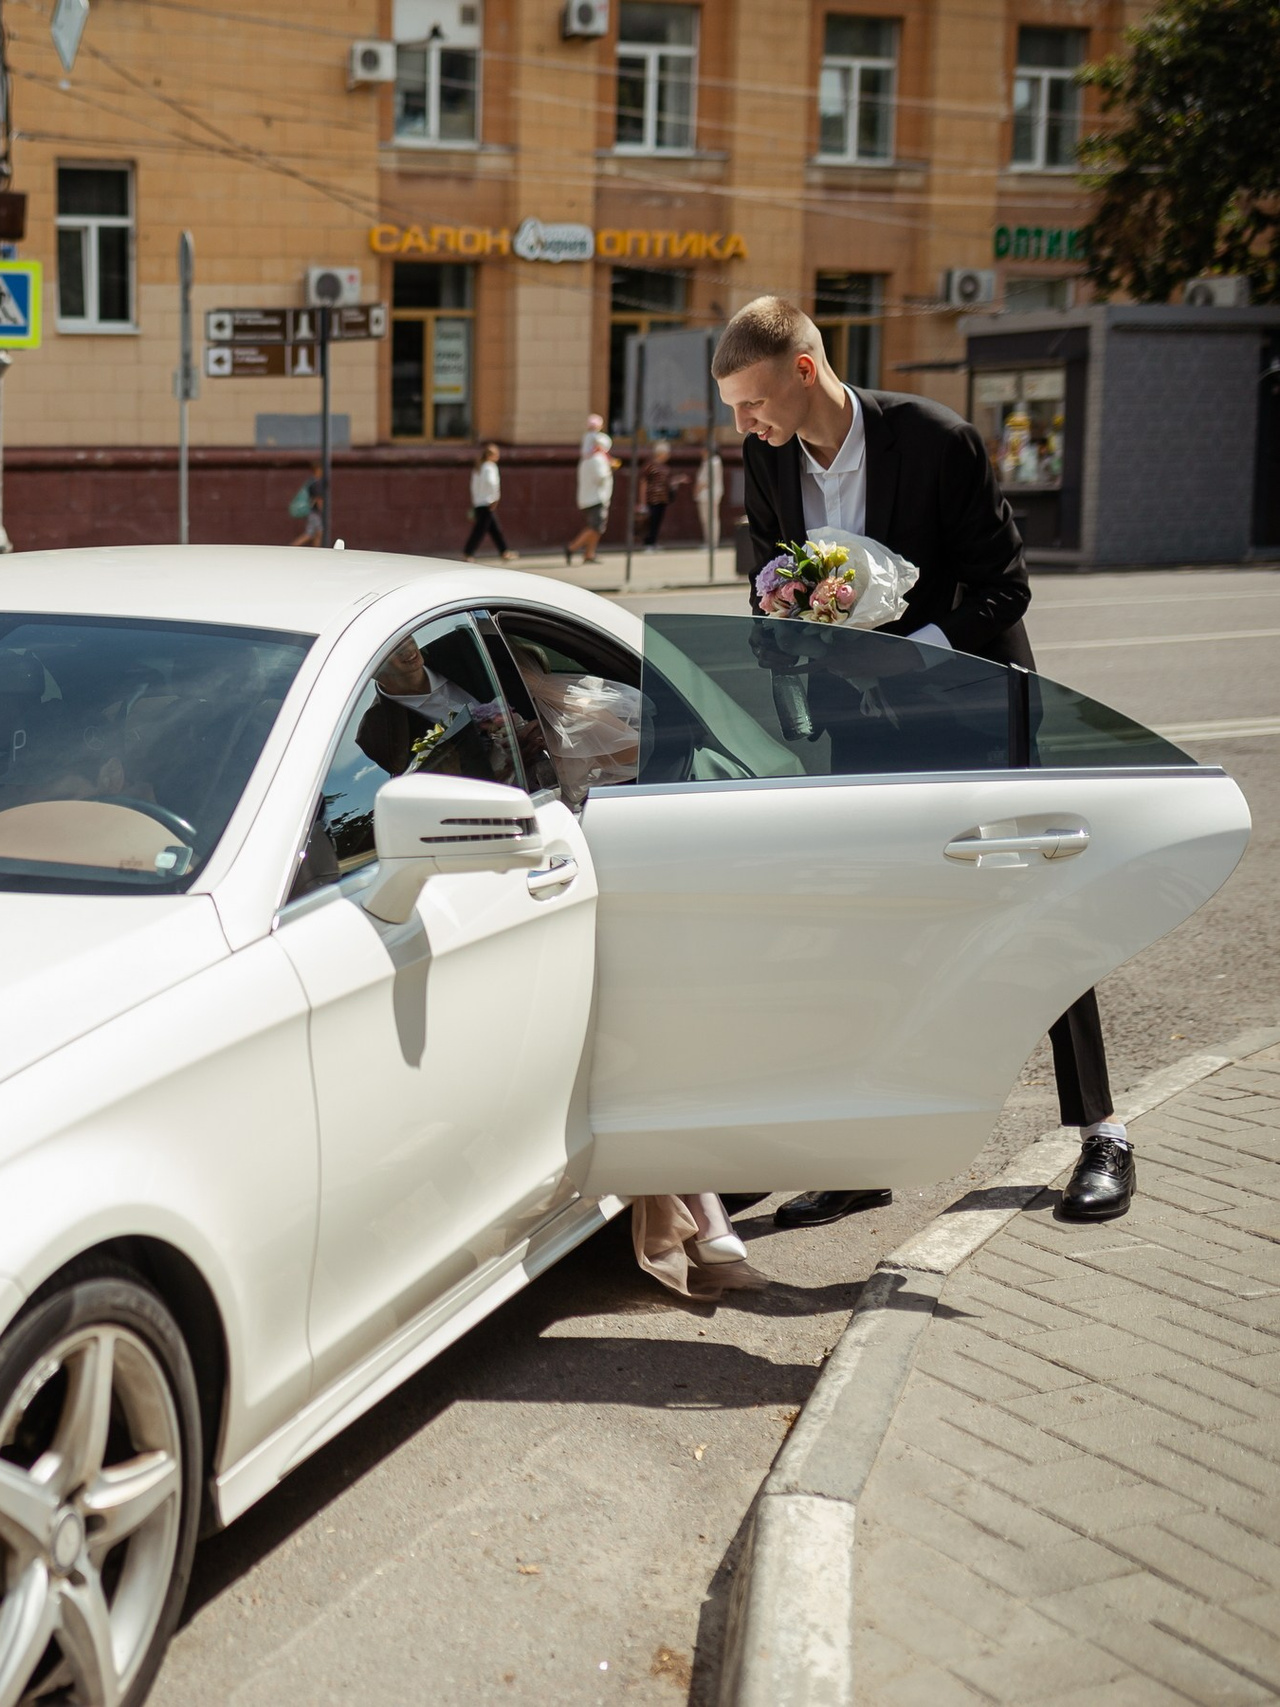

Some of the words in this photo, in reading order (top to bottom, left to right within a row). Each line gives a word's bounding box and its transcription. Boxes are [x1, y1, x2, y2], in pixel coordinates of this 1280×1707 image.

[369, 222, 510, 255] САЛОН
[597, 228, 748, 259] ОПТИКА
[995, 226, 1085, 258] ОПТИК
